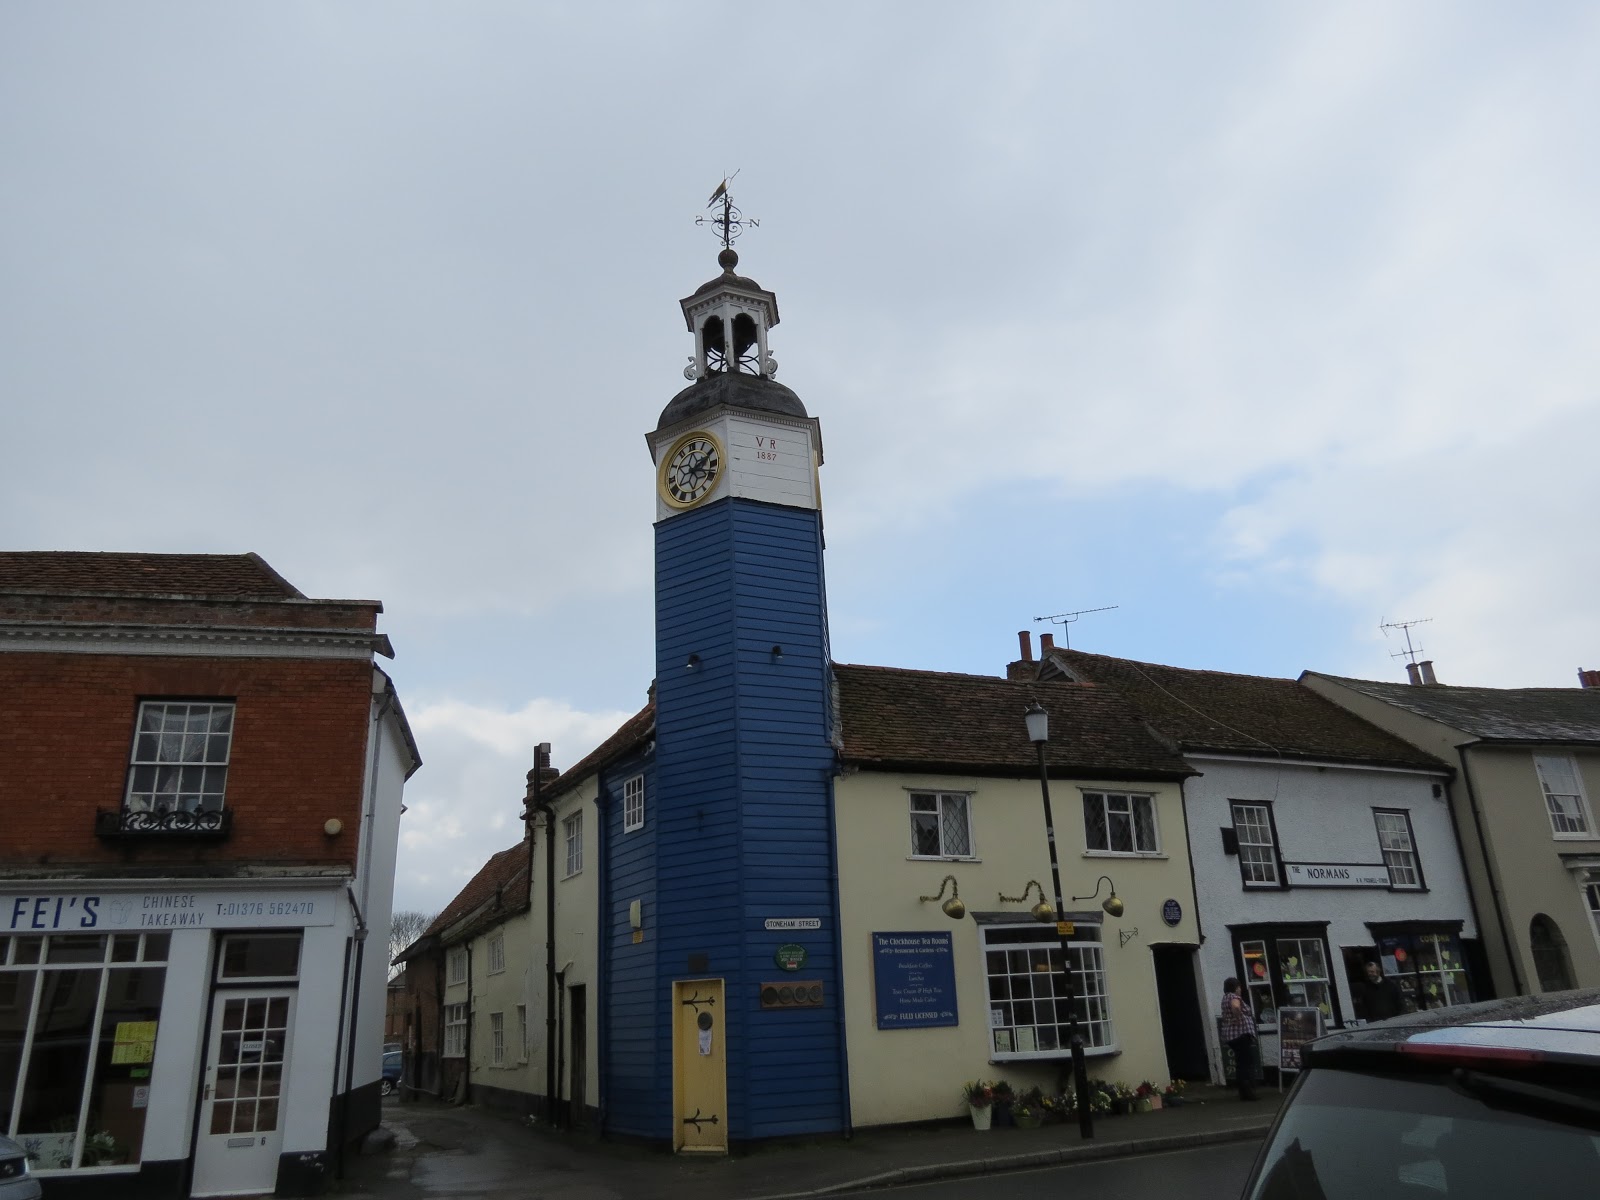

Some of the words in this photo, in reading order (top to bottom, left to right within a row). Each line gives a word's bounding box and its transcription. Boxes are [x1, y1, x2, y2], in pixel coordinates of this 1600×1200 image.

[757, 451, 777, 461] 1887
[1291, 866, 1300, 874] THE
[1307, 868, 1350, 879] NORMANS
[143, 895, 196, 909] CHINESE
[10, 896, 101, 929] FEI'S
[268, 902, 315, 915] 562470
[141, 912, 205, 926] TAKEAWAY
[261, 1136, 267, 1146] 6
